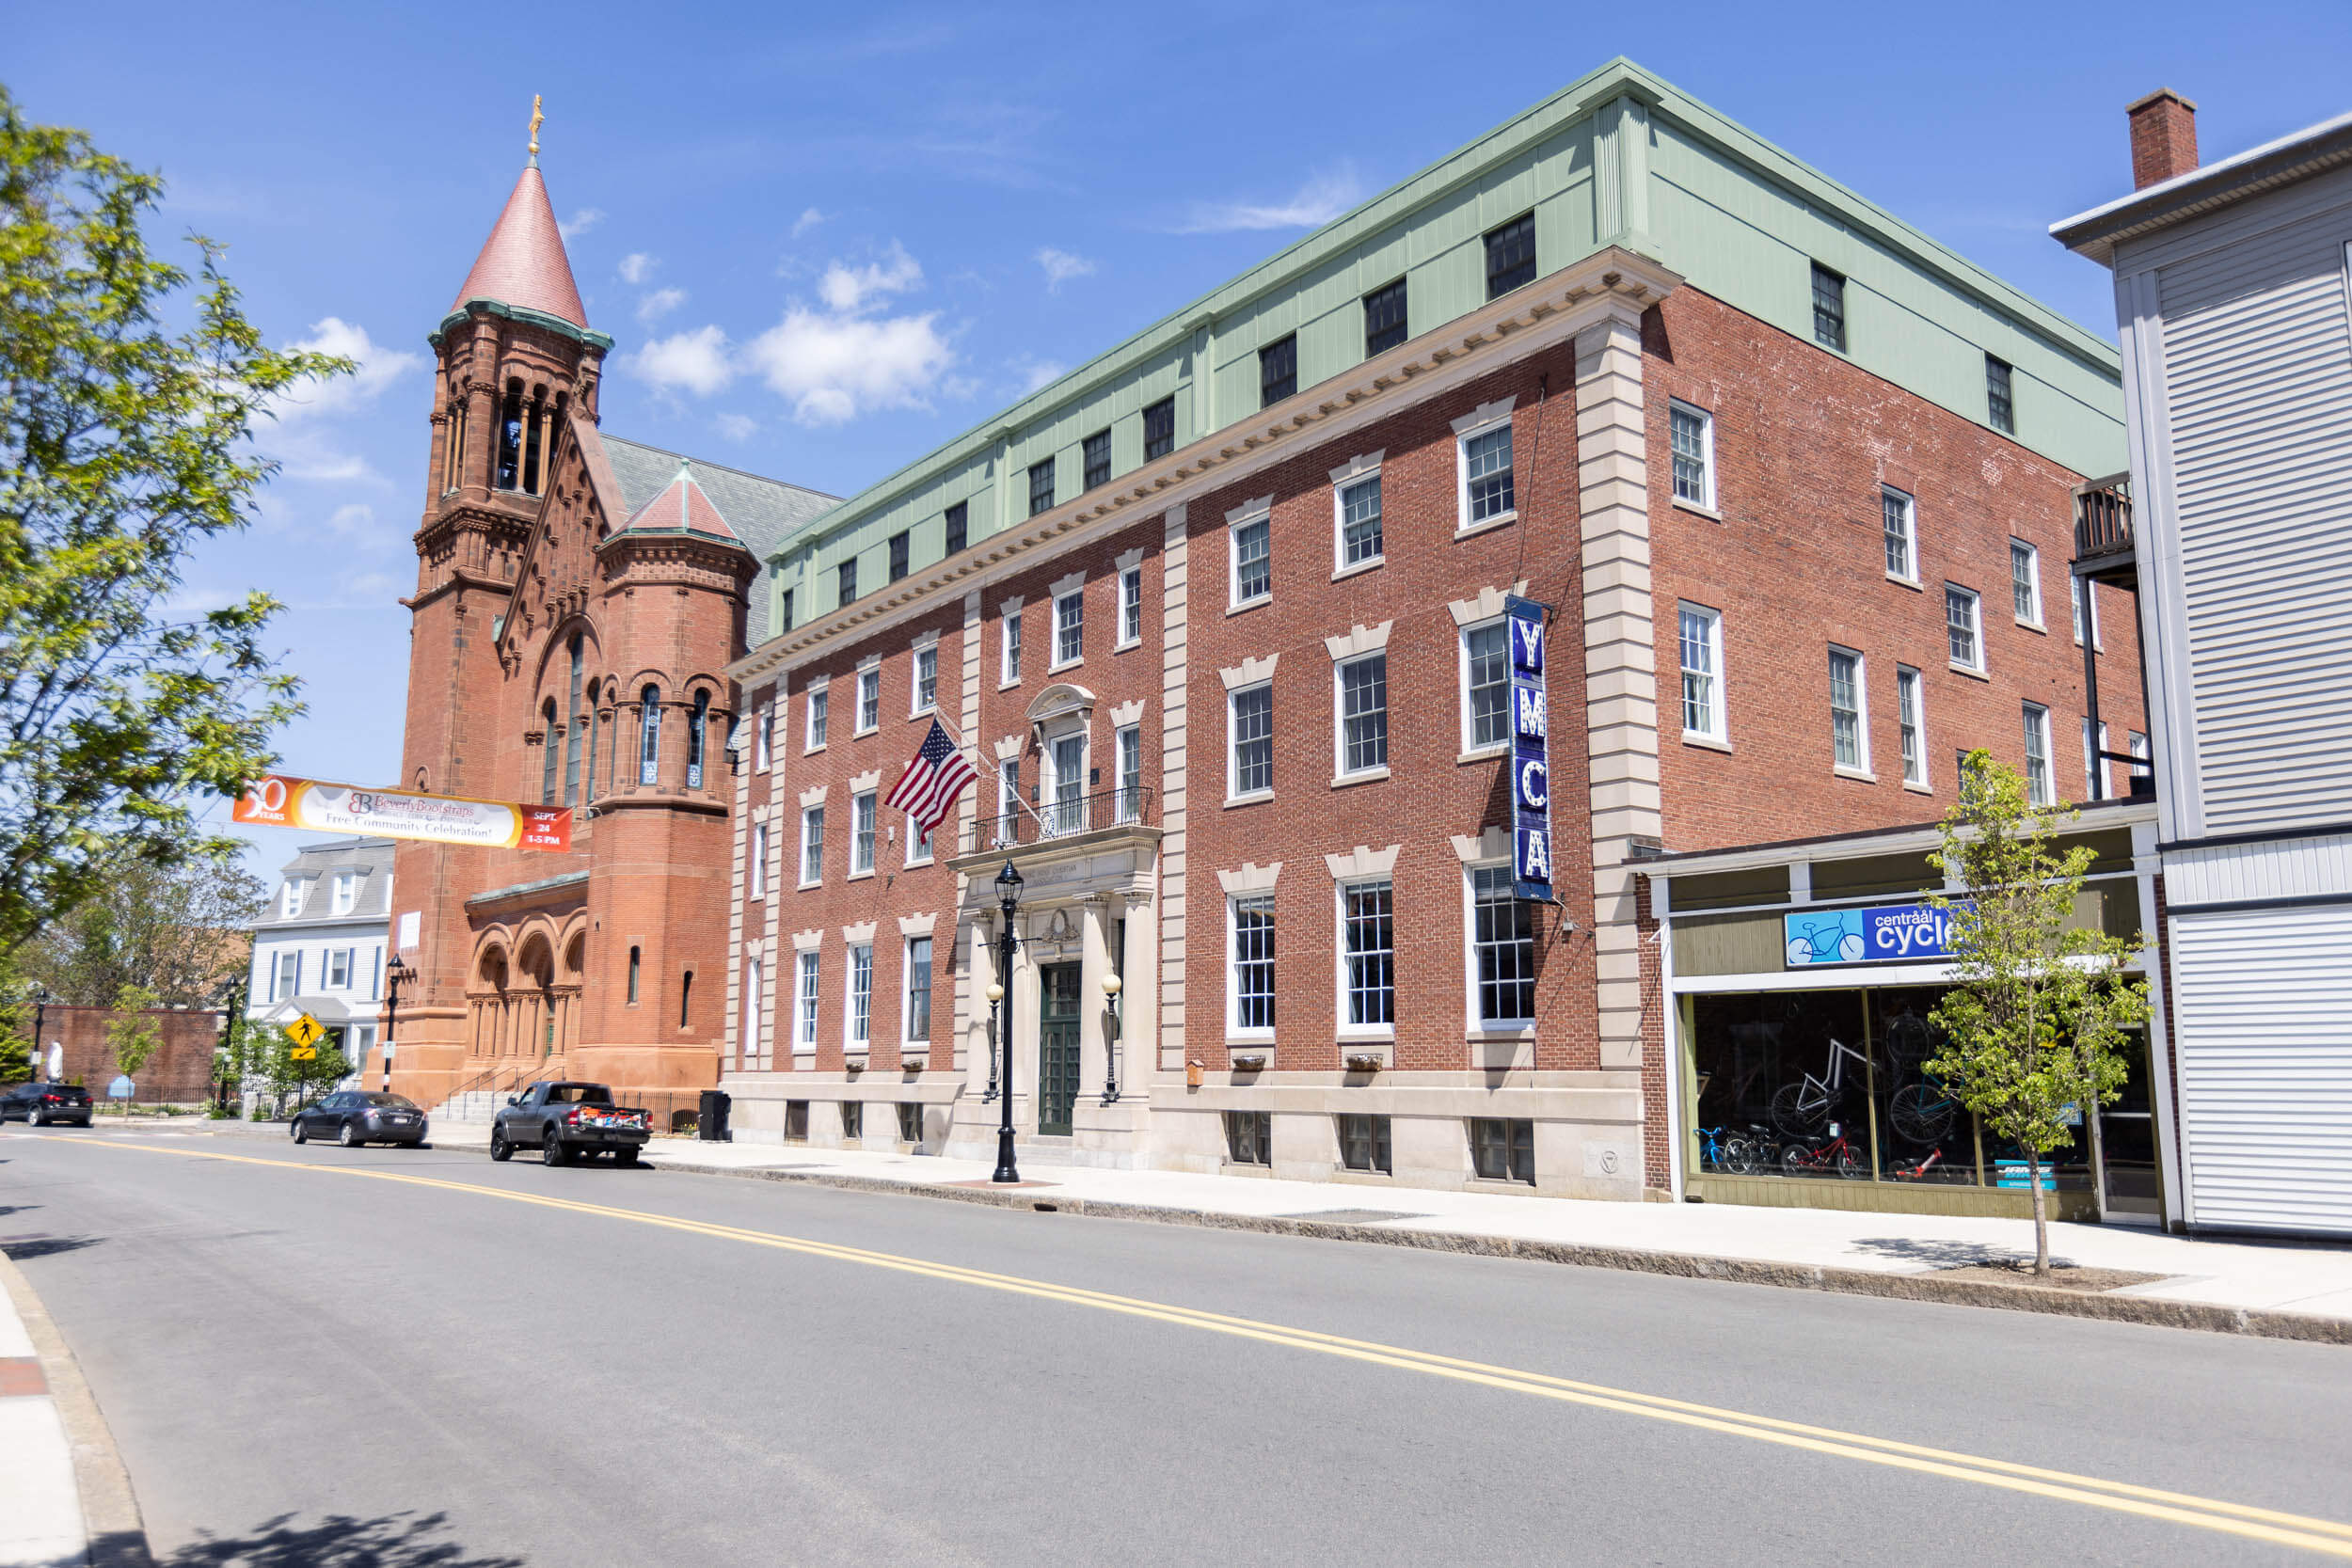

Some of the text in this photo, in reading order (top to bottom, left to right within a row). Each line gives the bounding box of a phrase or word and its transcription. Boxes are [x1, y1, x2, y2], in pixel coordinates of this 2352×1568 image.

[1516, 618, 1549, 878] YMCA
[259, 811, 286, 821] YEARS
[326, 812, 352, 824] Free
[544, 835, 561, 845] PM
